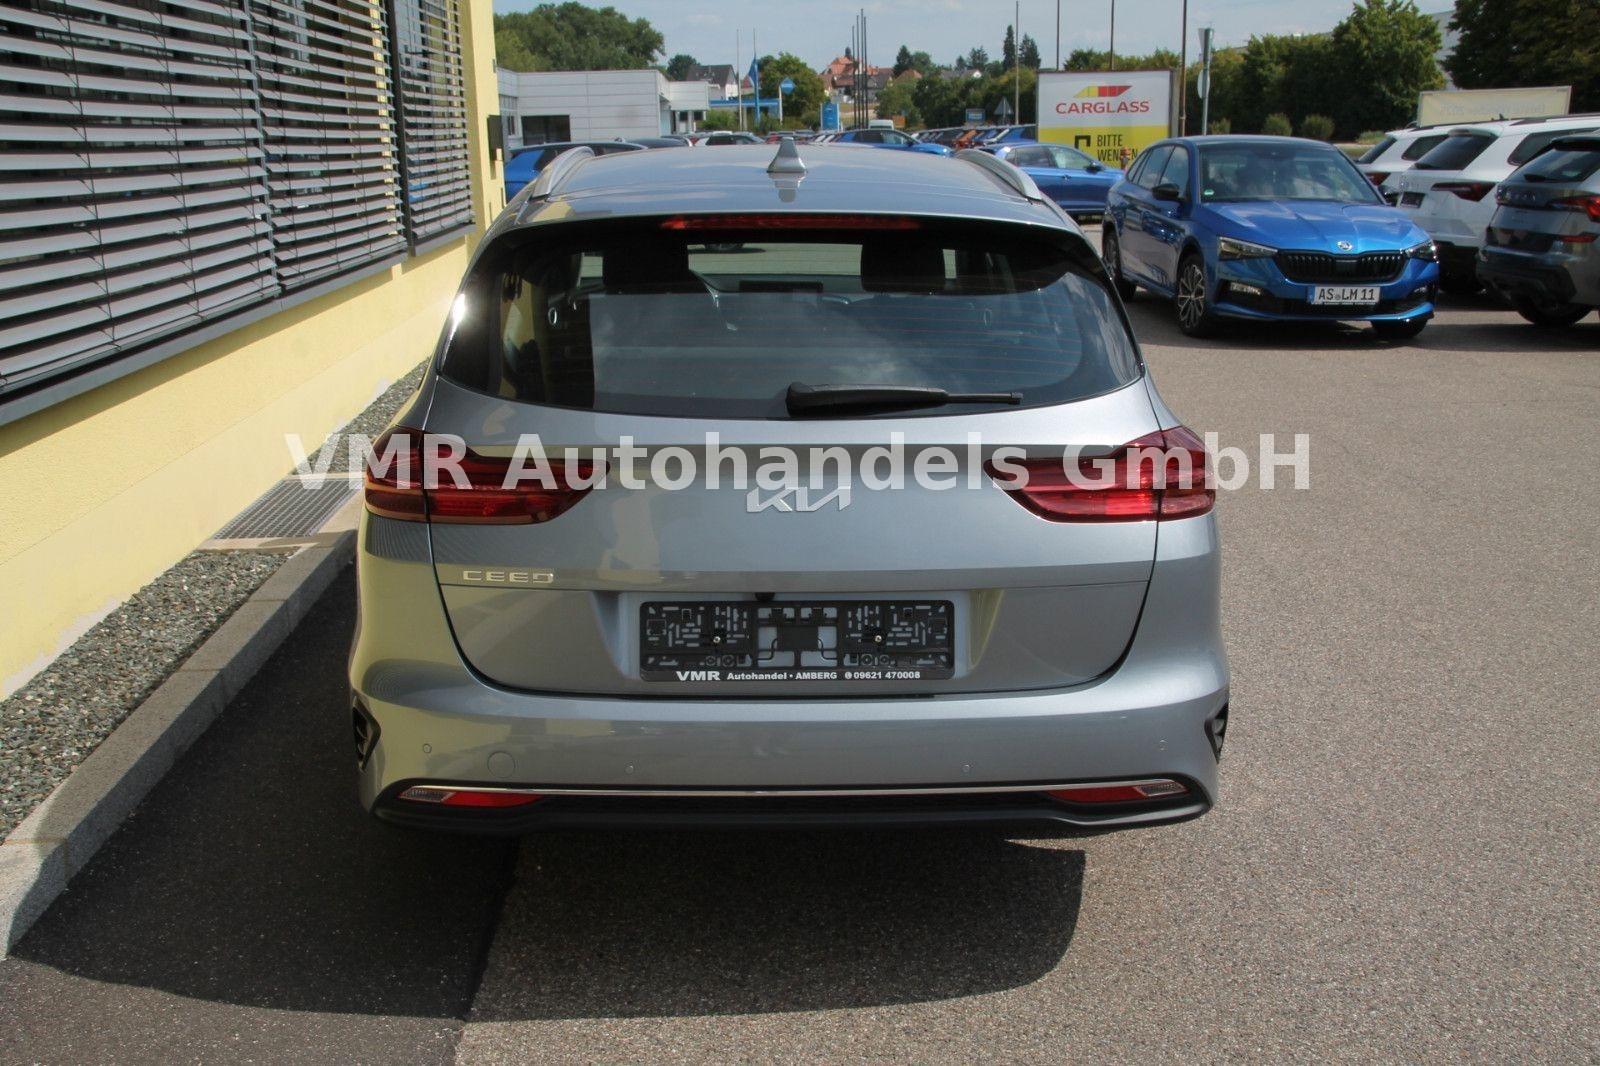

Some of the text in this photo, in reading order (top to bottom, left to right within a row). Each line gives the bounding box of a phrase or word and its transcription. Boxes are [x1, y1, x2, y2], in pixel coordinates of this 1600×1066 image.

[1055, 101, 1150, 115] CARGLASS
[1097, 134, 1123, 147] BITTE
[1097, 149, 1138, 162] WENN
[1319, 288, 1375, 301] AS LM 11
[746, 486, 851, 513] KIA
[462, 570, 554, 584] CEED
[676, 671, 721, 681] VMR
[727, 672, 787, 680] Autohandel
[795, 671, 838, 680] AMBERG
[853, 671, 882, 679] 09621
